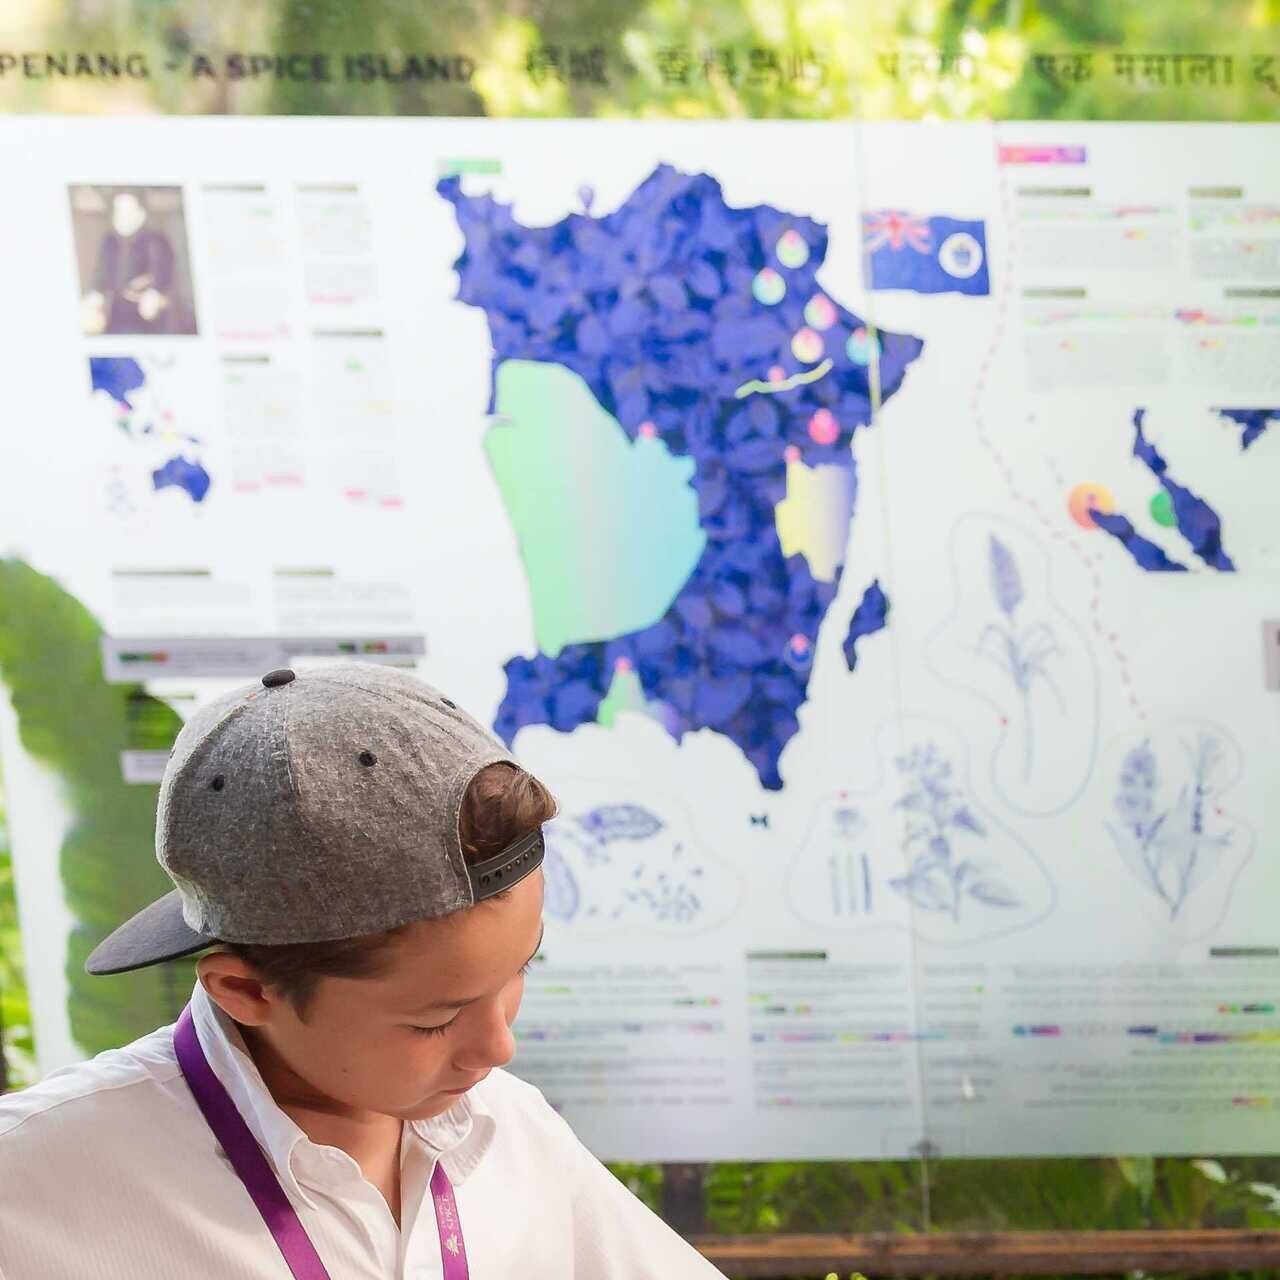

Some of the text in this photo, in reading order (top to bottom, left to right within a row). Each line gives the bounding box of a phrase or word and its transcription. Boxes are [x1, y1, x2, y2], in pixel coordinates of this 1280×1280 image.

[0, 52, 149, 78] PENANG
[191, 54, 216, 78] A
[226, 53, 330, 81] SPICE
[346, 54, 474, 82] ISLAND
